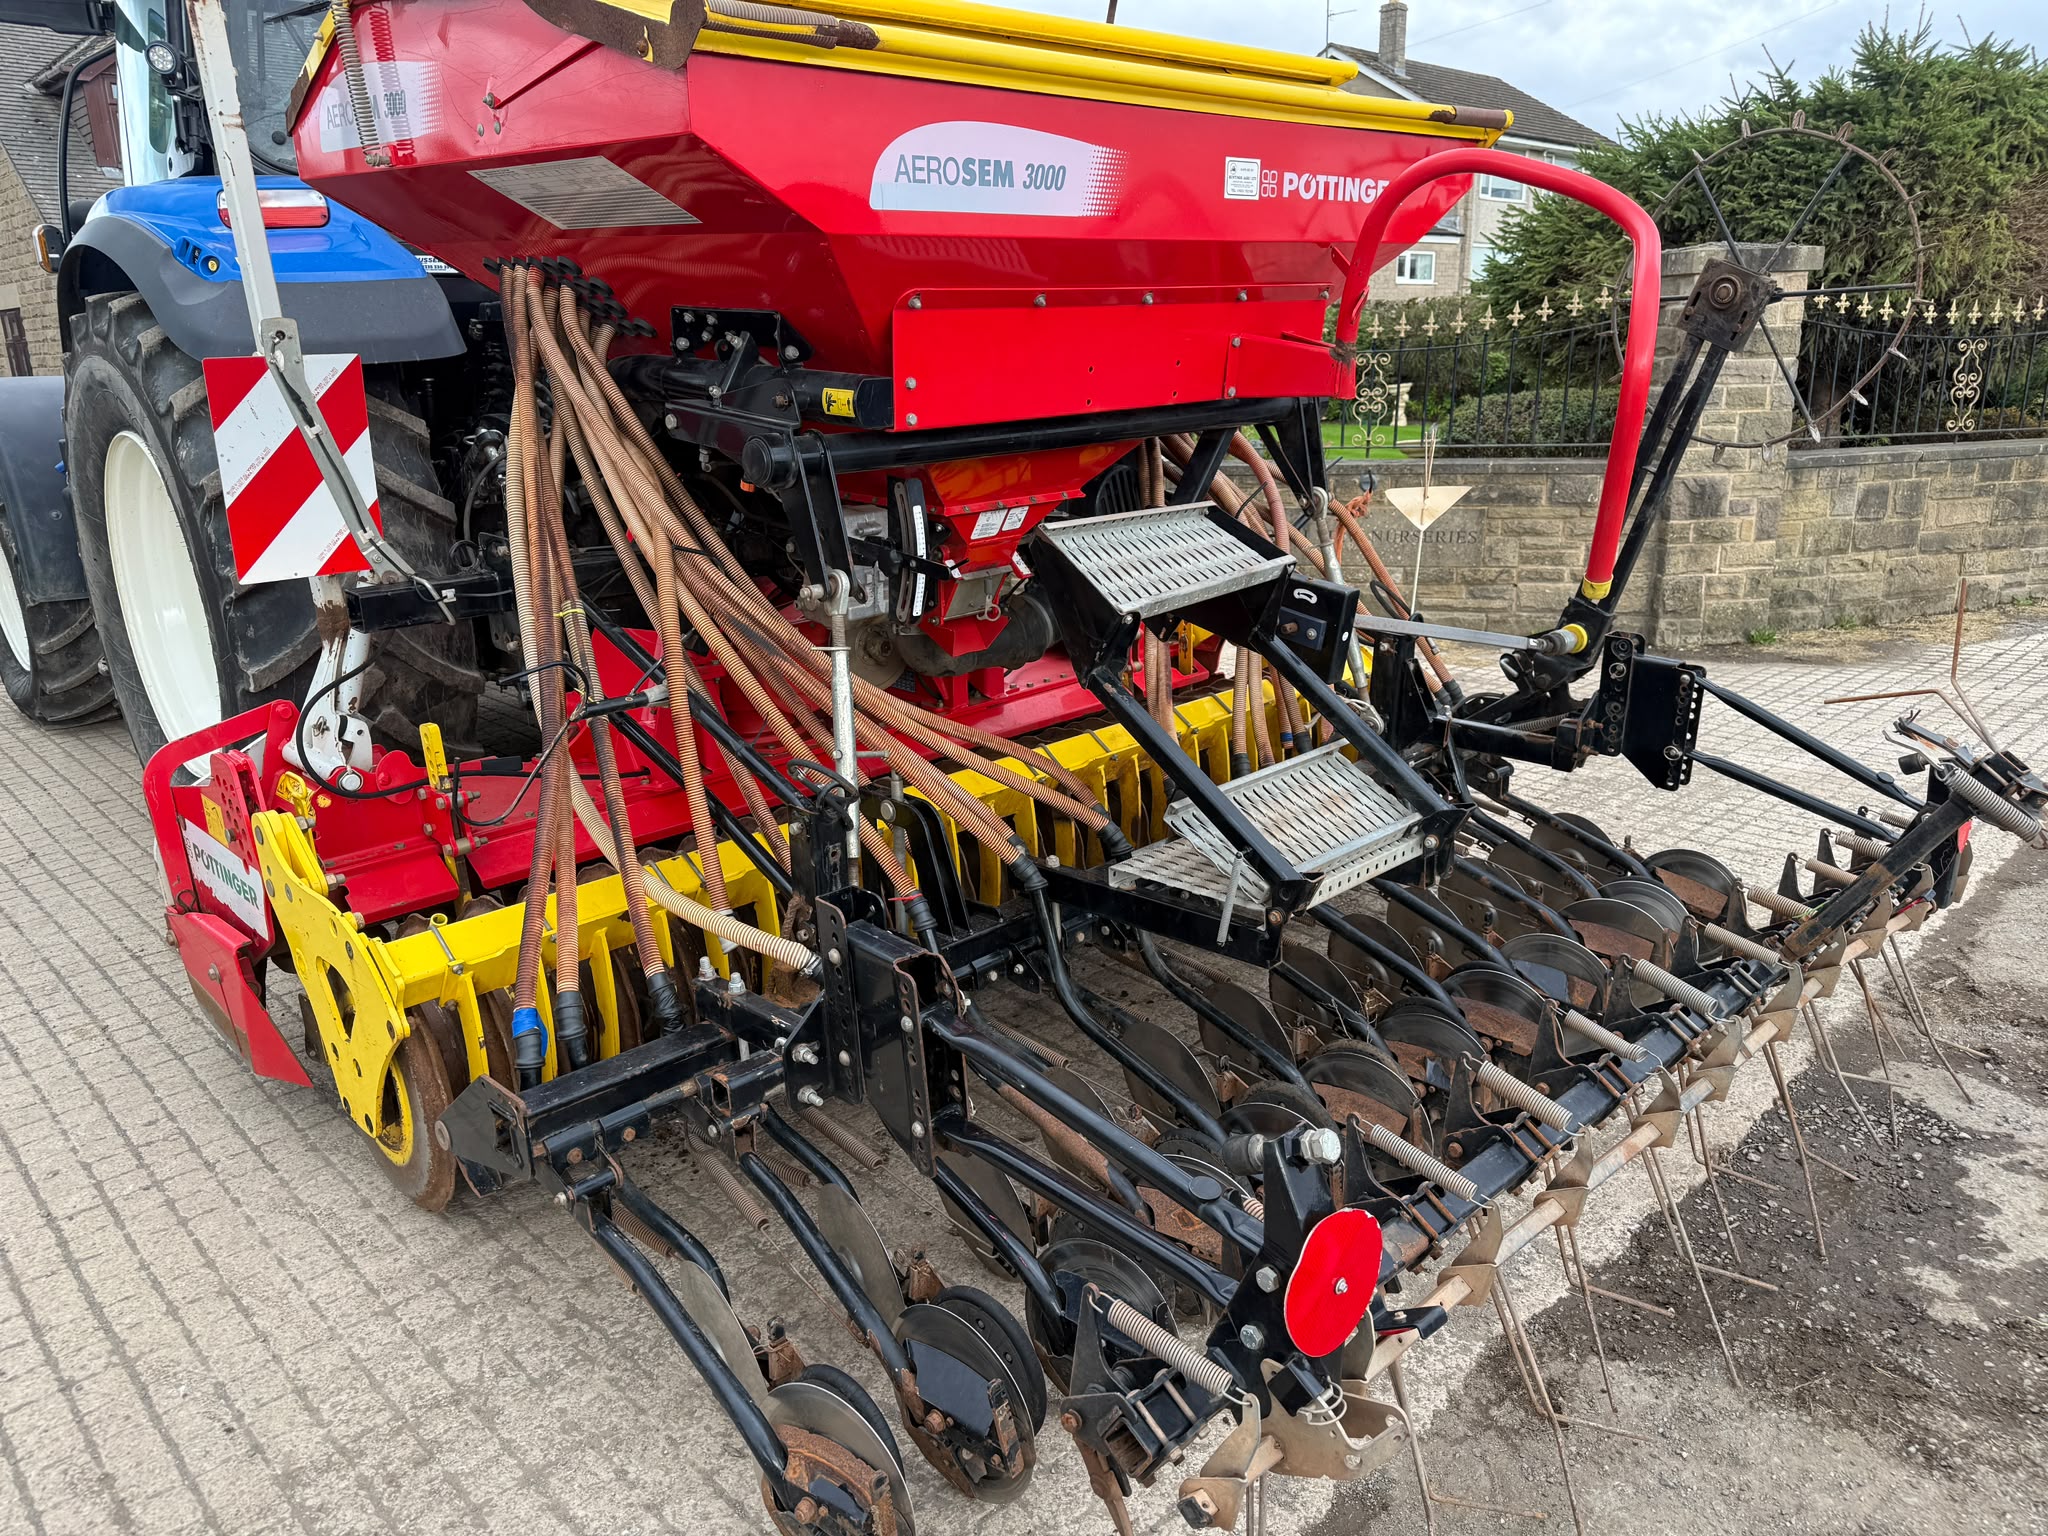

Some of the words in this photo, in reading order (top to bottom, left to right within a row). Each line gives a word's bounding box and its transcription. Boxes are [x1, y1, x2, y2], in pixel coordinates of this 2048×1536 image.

[326, 93, 381, 130] AEROM
[383, 89, 407, 119] 3000
[894, 153, 1015, 189] AEROSEM
[1022, 162, 1067, 192] 3000
[1282, 171, 1391, 204] PÖTTINGE
[1371, 529, 1479, 546] NURSERIES
